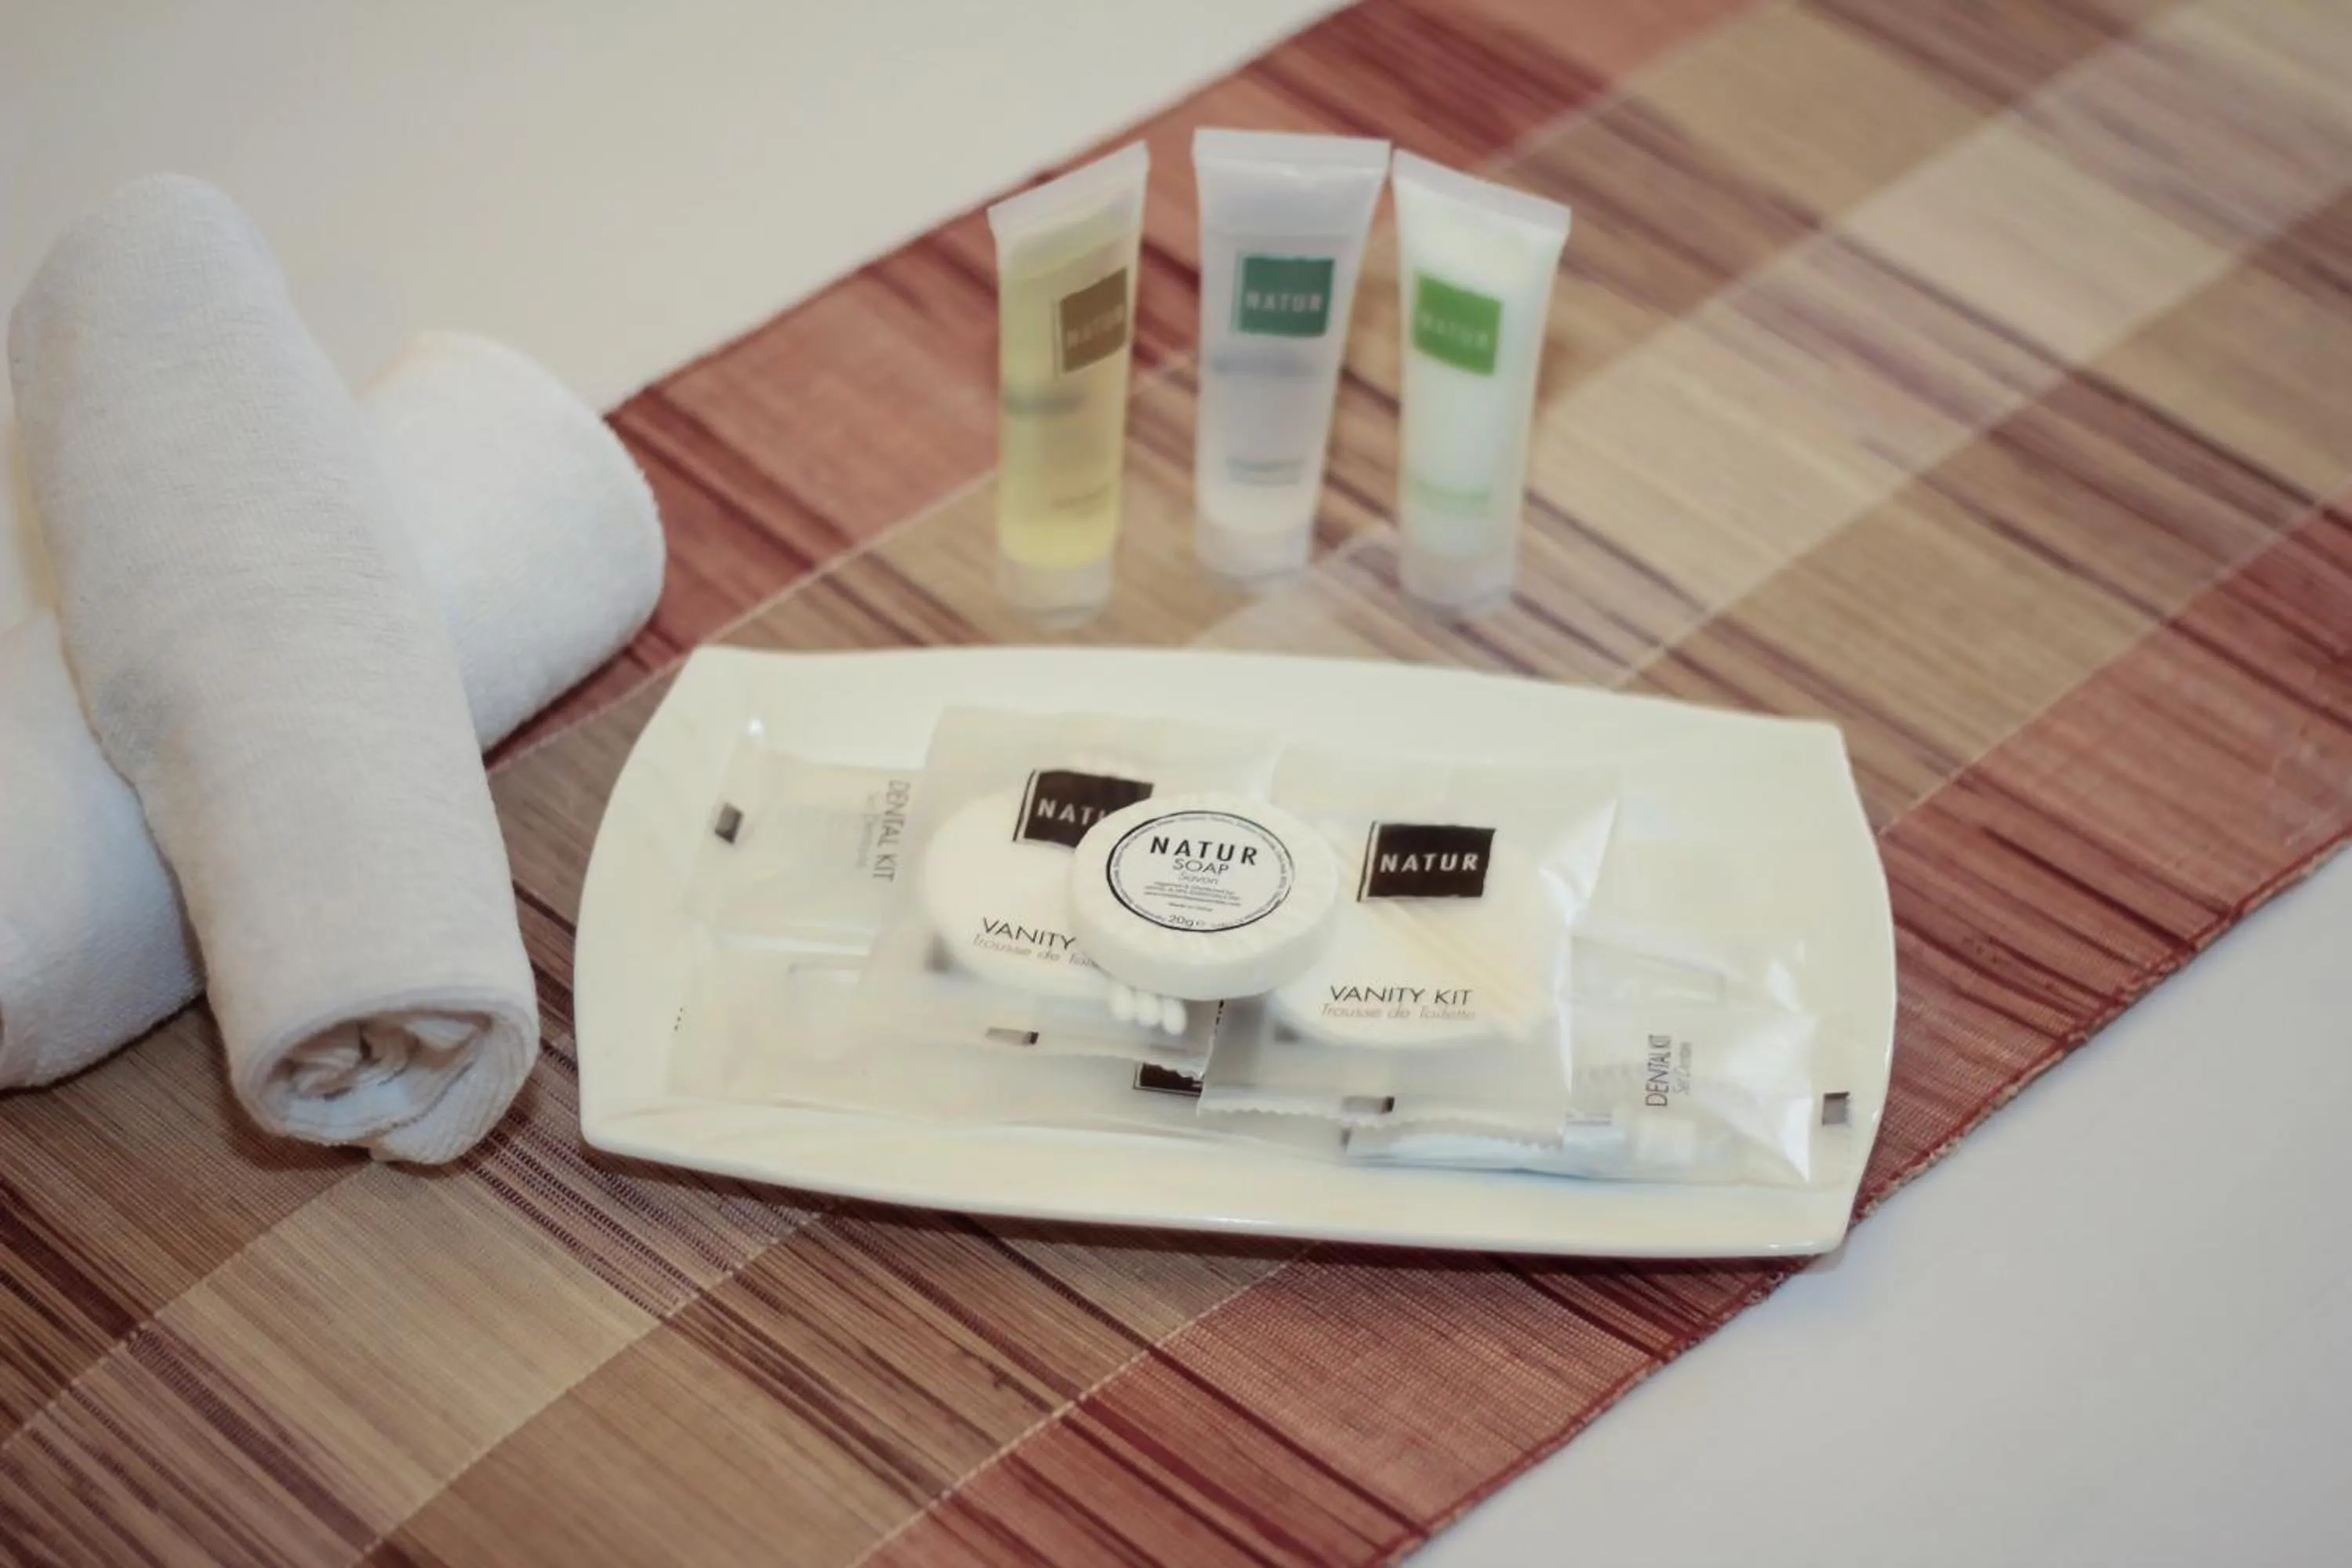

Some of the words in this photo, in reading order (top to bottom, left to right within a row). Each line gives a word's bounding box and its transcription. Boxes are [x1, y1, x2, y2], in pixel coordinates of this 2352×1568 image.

[1245, 289, 1324, 314] NATUR
[877, 779, 911, 848] DENTAL
[1036, 797, 1107, 826] NAT
[1149, 835, 1258, 866] NATUR
[1378, 852, 1480, 873] NATUR
[872, 853, 899, 882] KIT
[1172, 858, 1230, 876] SOAP
[1178, 870, 1219, 886] Savon
[982, 916, 1077, 951] VANITY
[1330, 985, 1427, 1004] VANITY
[1433, 988, 1474, 1006] KIT
[1386, 1002, 1411, 1019] de
[1644, 1051, 1672, 1107] DENTAL
